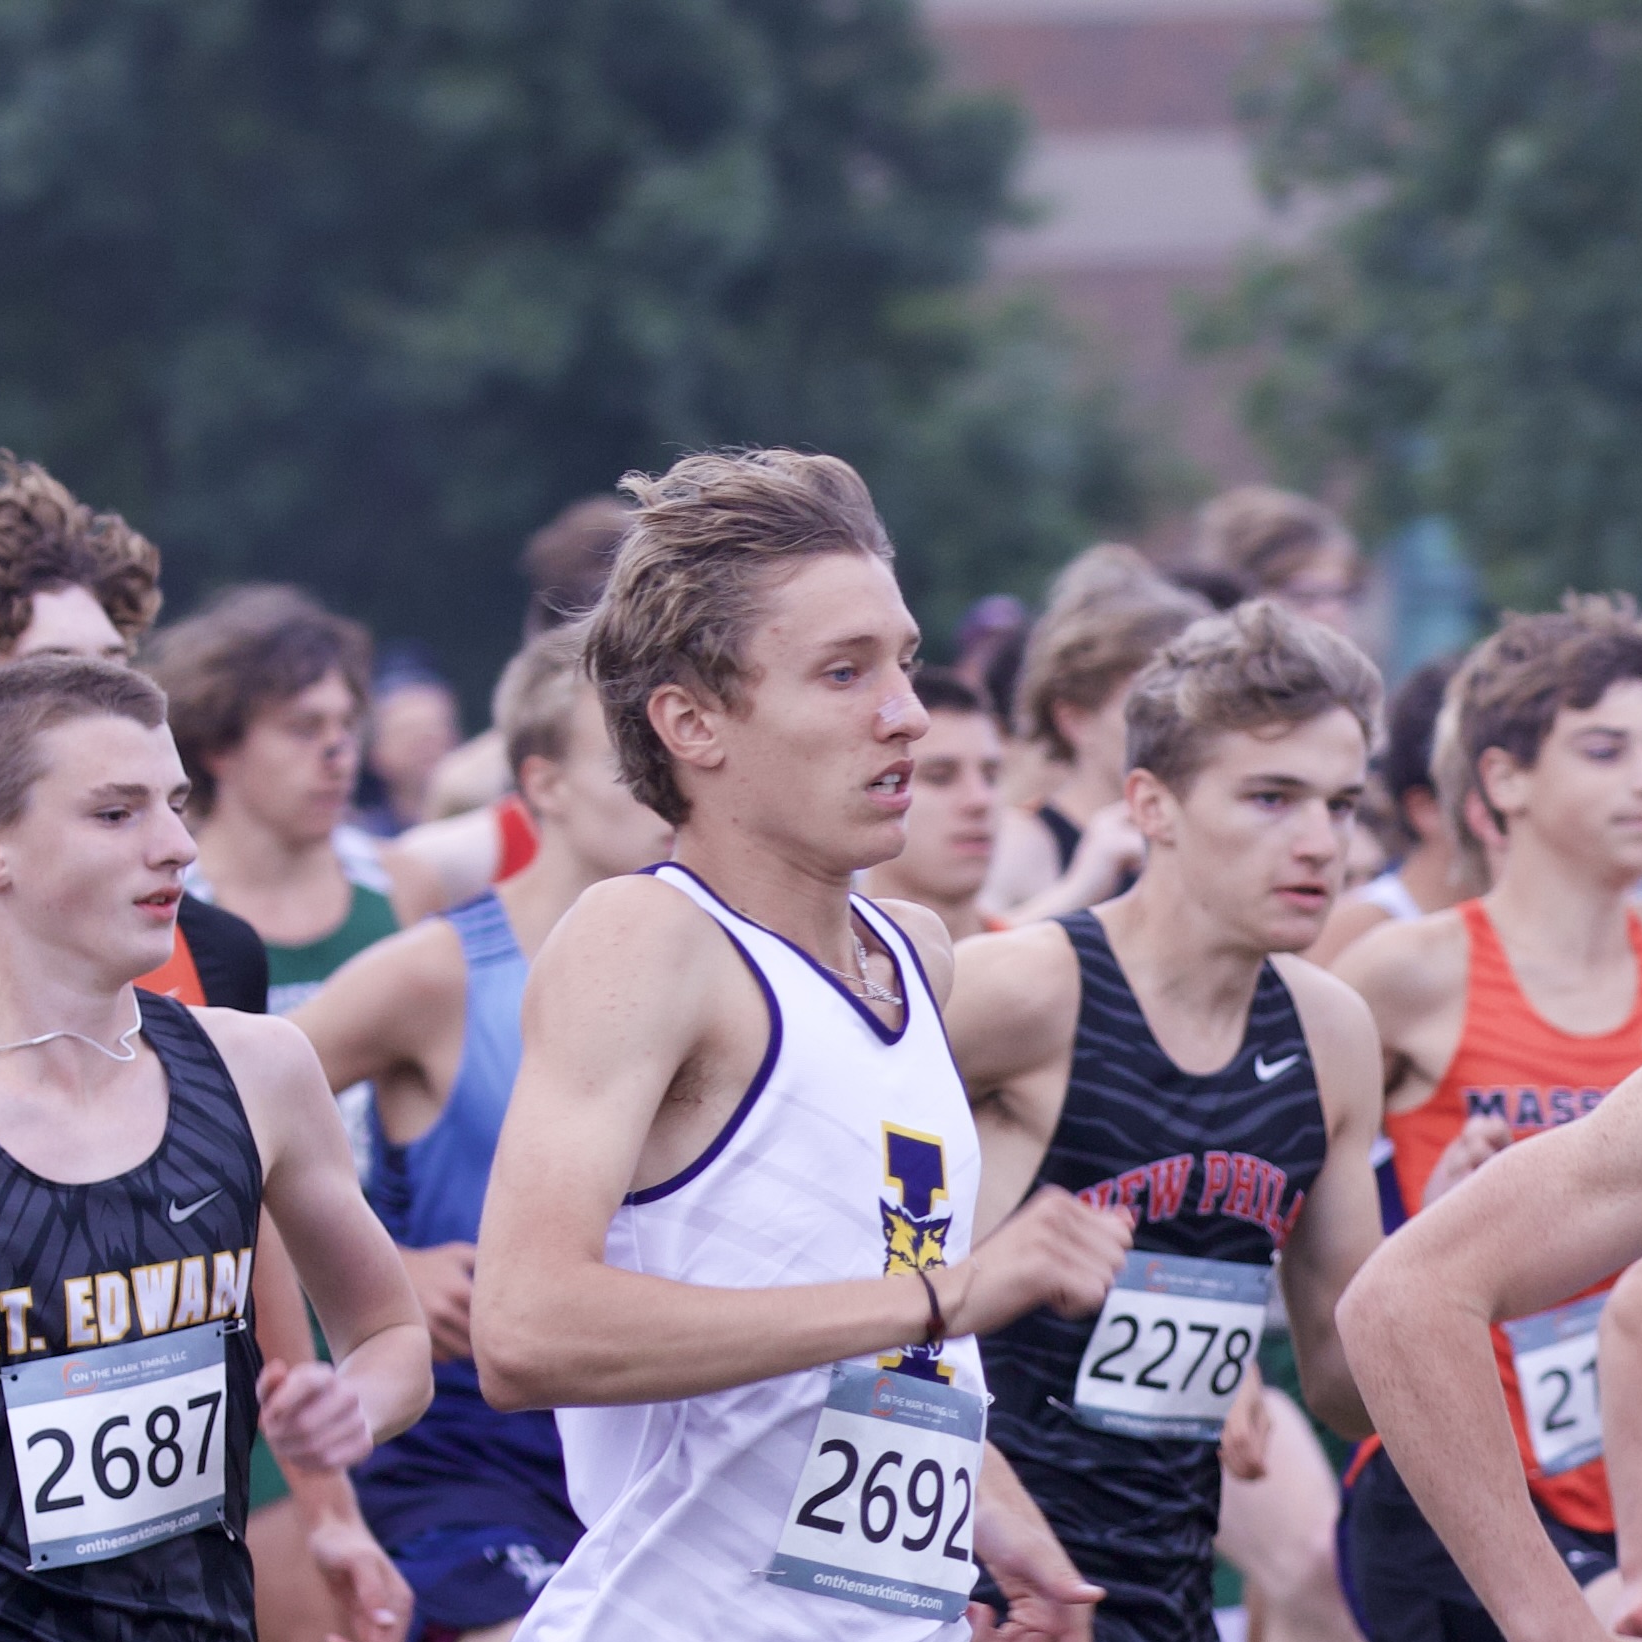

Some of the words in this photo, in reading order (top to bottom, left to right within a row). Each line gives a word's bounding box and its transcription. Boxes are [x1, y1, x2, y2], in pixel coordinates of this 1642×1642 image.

[71, 1372, 89, 1384] ON
[90, 1366, 110, 1382] THE
[112, 1361, 139, 1376] MARK
[172, 1350, 188, 1362] LLC
[1089, 1313, 1252, 1396] 2278
[26, 1390, 223, 1514] 2687
[795, 1439, 970, 1562] 2692
[76, 1511, 200, 1555] onthemarktiming.com
[813, 1572, 943, 1610] onthemarktiming.com
